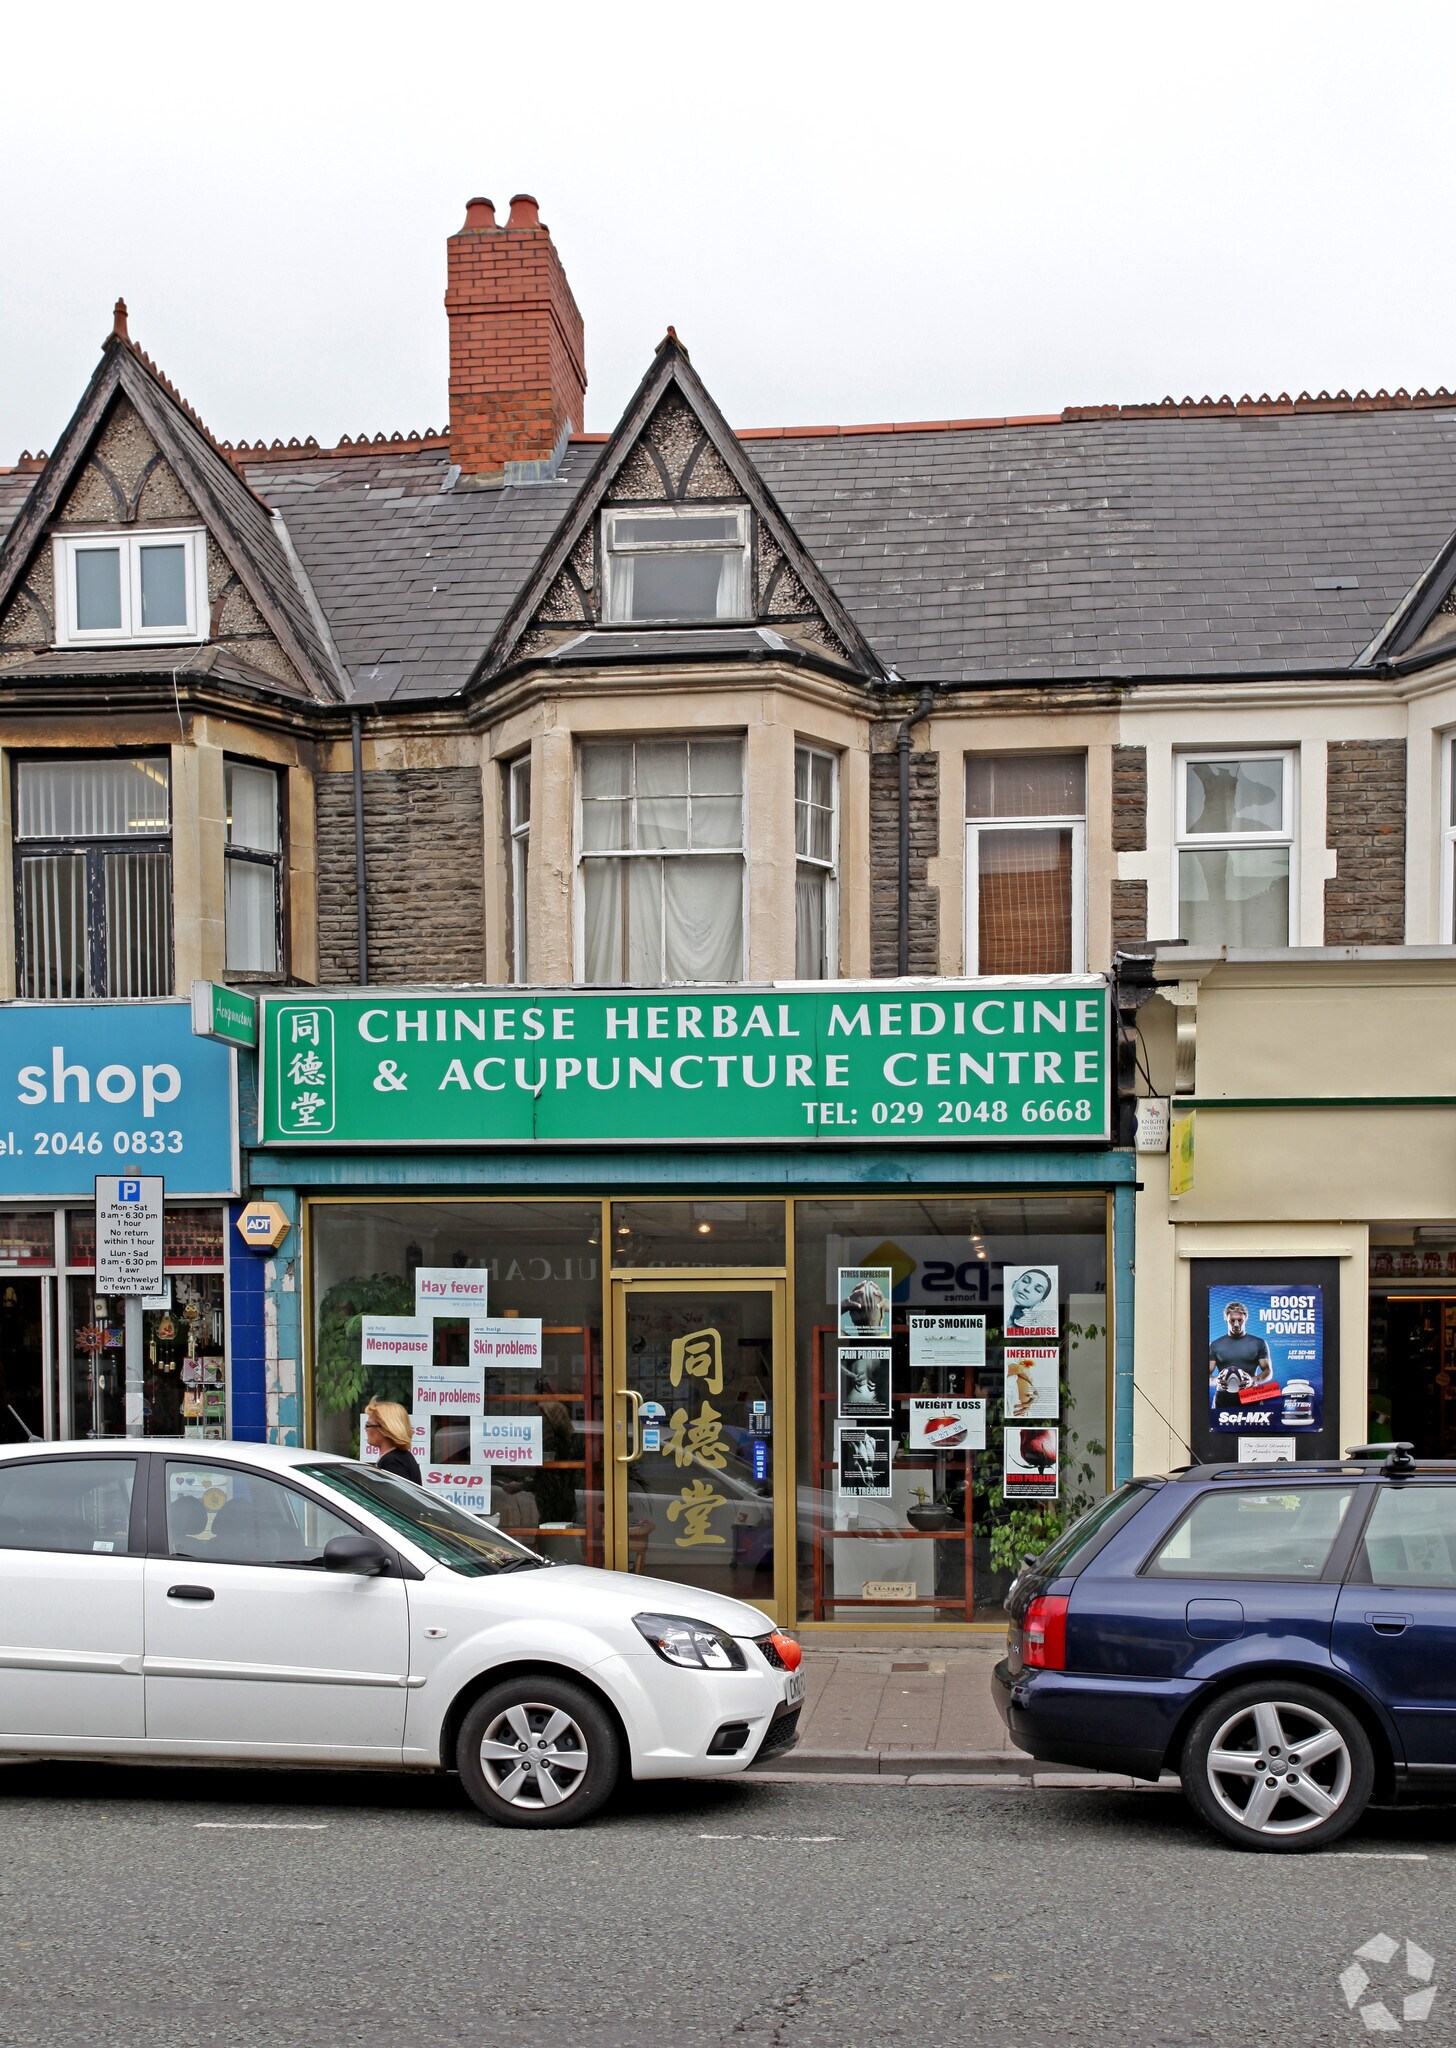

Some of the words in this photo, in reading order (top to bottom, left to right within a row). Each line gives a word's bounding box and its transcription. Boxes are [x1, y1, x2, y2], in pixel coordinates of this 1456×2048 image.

[358, 1008, 575, 1043] CHINESE
[606, 1005, 800, 1040] HERBAL
[827, 1000, 1099, 1037] MEDICINE
[287, 1011, 326, 1127] 同德堂
[373, 1059, 408, 1092] &
[439, 1054, 850, 1094] ACUPUNCTURE
[883, 1050, 1099, 1087] CENTRE
[17, 1046, 182, 1118] shop
[802, 1101, 858, 1125] TEL:
[871, 1101, 924, 1125] 029
[938, 1100, 1008, 1124] 2048
[1021, 1099, 1092, 1122] 6668
[34, 1131, 103, 1155] 2046
[113, 1130, 183, 1154] 0833
[123, 1182, 137, 1200] P
[134, 1203, 148, 1211] Sat
[145, 1213, 158, 1221] pm
[247, 1219, 270, 1231] ADT
[125, 1258, 144, 1266] 6.30
[99, 1275, 114, 1283] Dim
[117, 1275, 159, 1284] dychwelyd
[841, 1270, 860, 1278] STRESS
[860, 1270, 890, 1278] DEPRESSION
[421, 1280, 447, 1296] Hay
[451, 1281, 485, 1294] fever
[1270, 1296, 1316, 1308] BOOST
[1259, 1309, 1316, 1321] MUSCLE
[911, 1318, 936, 1329] STOP
[938, 1318, 984, 1329] SMOKING
[1266, 1322, 1316, 1334] POWER
[1006, 1326, 1056, 1336] MENOPAUSE
[366, 1338, 428, 1354] Menopause
[473, 1339, 493, 1355] Skin
[495, 1341, 538, 1358] problems
[840, 1350, 857, 1359] PAIN
[857, 1350, 890, 1359] PROBLEM
[1006, 1349, 1057, 1358] INFERTILITY
[417, 1387, 437, 1403] Pain
[439, 1388, 481, 1406] problems
[915, 1401, 953, 1410] WEIGHT
[957, 1400, 981, 1410] LOSS
[1218, 1411, 1271, 1423] Sci-MX
[482, 1422, 532, 1441] Losing
[661, 1327, 730, 1547] 同德堂
[483, 1447, 533, 1463] weight
[426, 1472, 484, 1487] Stop
[1024, 1474, 1057, 1482] PROBLEM
[841, 1487, 858, 1495] MALE
[858, 1487, 890, 1495] TREASURE
[440, 1491, 485, 1510] oking
